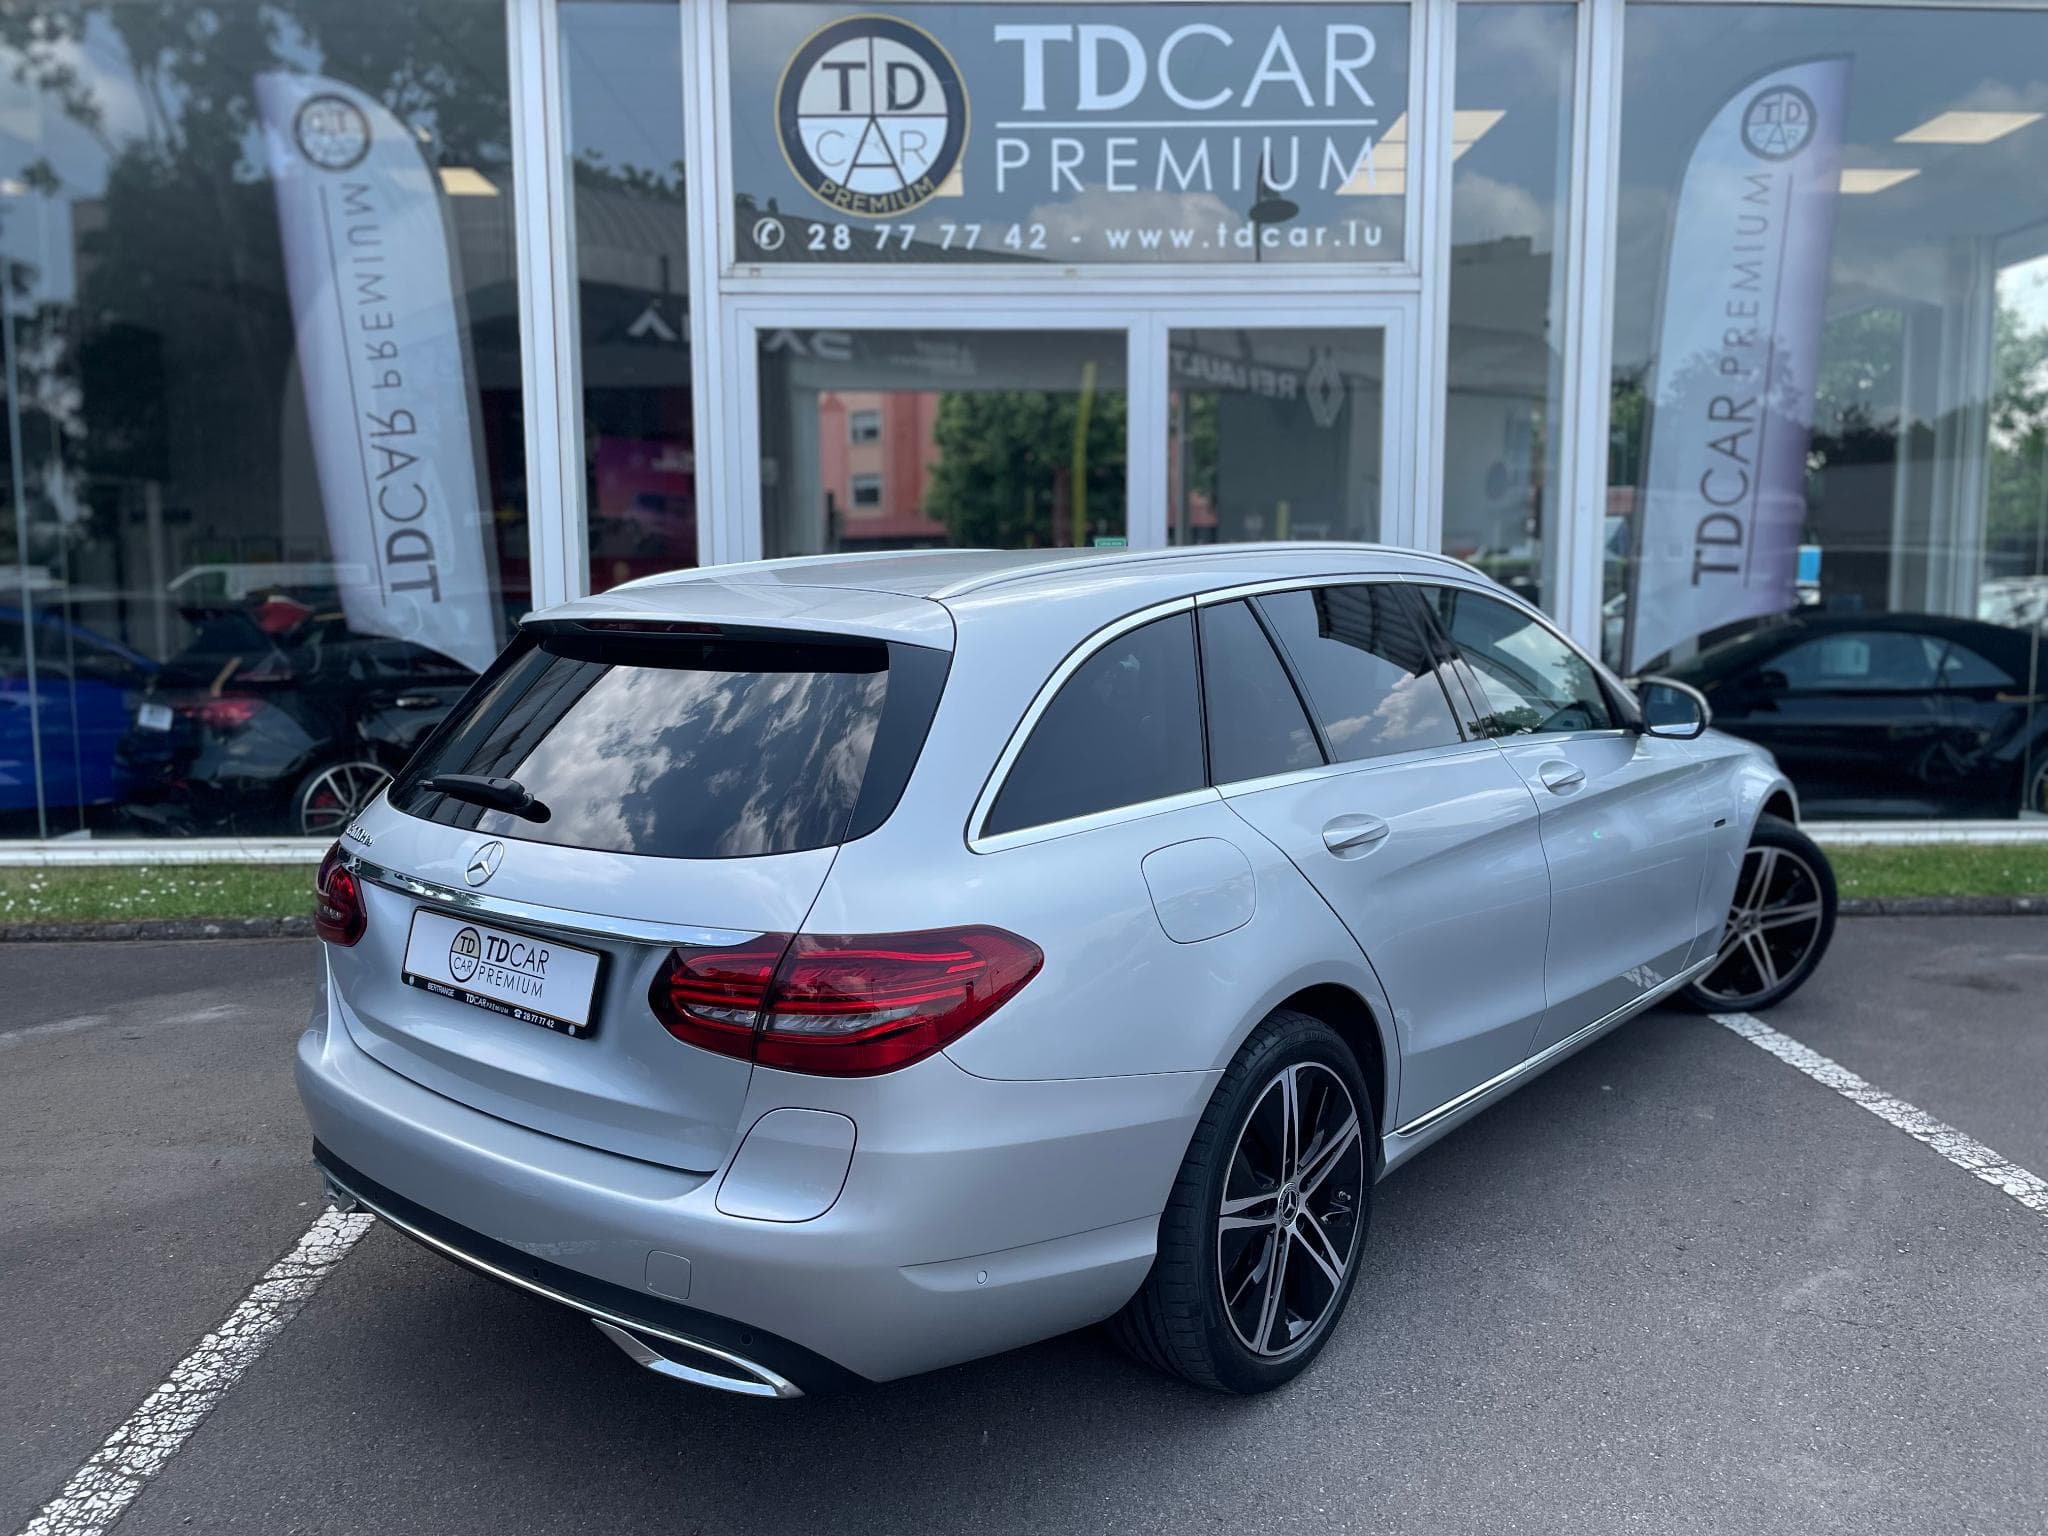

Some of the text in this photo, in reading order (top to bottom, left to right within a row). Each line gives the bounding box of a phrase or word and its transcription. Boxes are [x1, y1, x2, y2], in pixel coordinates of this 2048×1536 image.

[994, 23, 1377, 111] TDCAR
[996, 137, 1378, 192] PREMIUM
[817, 176, 935, 213] PREMIUM
[807, 223, 851, 250] 28
[874, 224, 916, 250] 77
[940, 224, 982, 250] 77
[1004, 223, 1047, 250] 42
[1105, 220, 1382, 249] www.tdcar.lu
[1691, 172, 1773, 586] TDCAR PREMIUM
[460, 935, 476, 954] TD
[486, 935, 549, 974] TDCAR
[453, 957, 473, 974] CAR
[478, 965, 543, 998] PREMIUM
[523, 1011, 531, 1021] 28
[531, 1013, 539, 1023] 77
[538, 1016, 546, 1026] 77
[547, 1019, 555, 1028] 42
